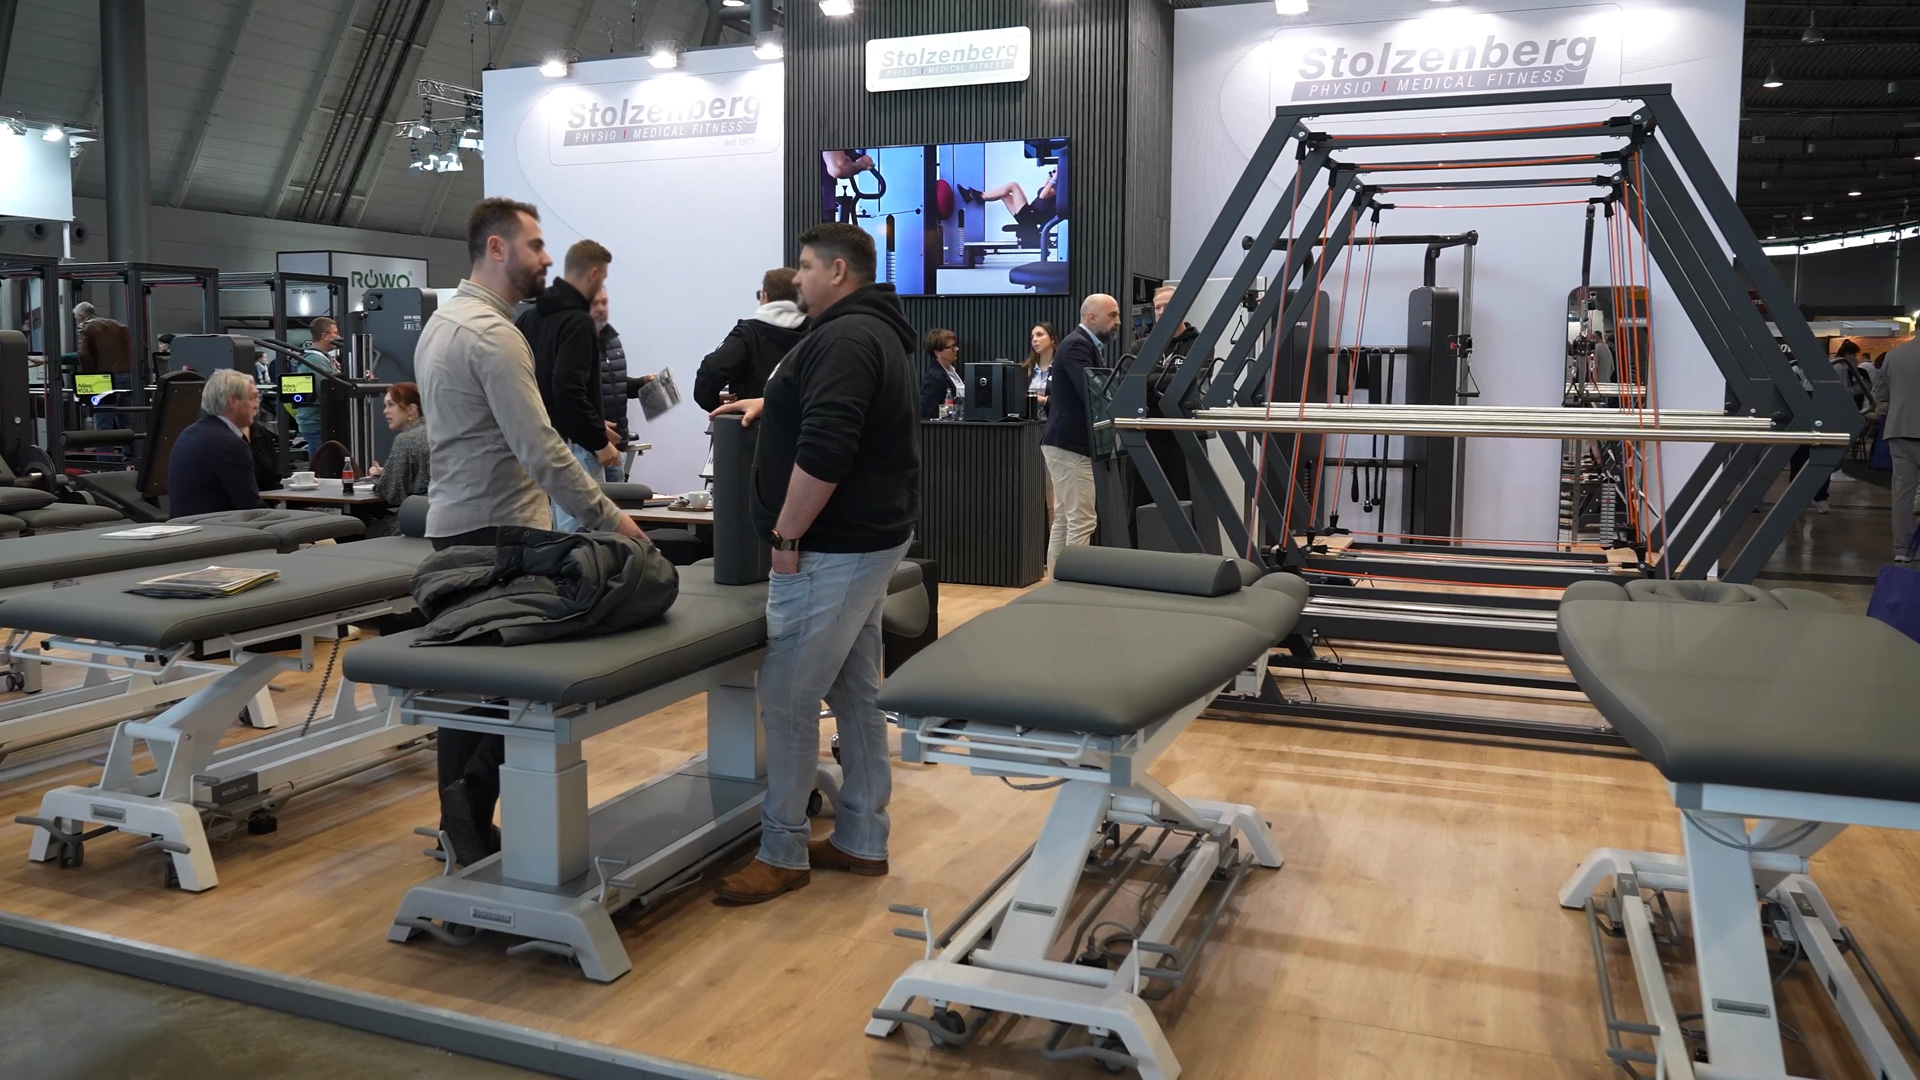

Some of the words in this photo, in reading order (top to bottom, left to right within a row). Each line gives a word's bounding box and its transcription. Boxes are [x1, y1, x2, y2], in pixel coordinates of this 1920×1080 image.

[882, 43, 1019, 68] Stolzenberg
[886, 69, 917, 77] PHYSIO
[928, 65, 965, 74] MEDICAL
[969, 60, 1006, 71] FITNESS
[1299, 34, 1597, 80] Stolzenberg
[1309, 81, 1372, 97] PHYSIO
[1397, 75, 1475, 92] MEDICAL
[1487, 68, 1565, 87] FITNESS
[567, 95, 761, 129] Stolzenberg
[575, 130, 617, 143] PHYSIO
[633, 125, 685, 139] MEDICAL
[692, 120, 744, 135] FITNESS
